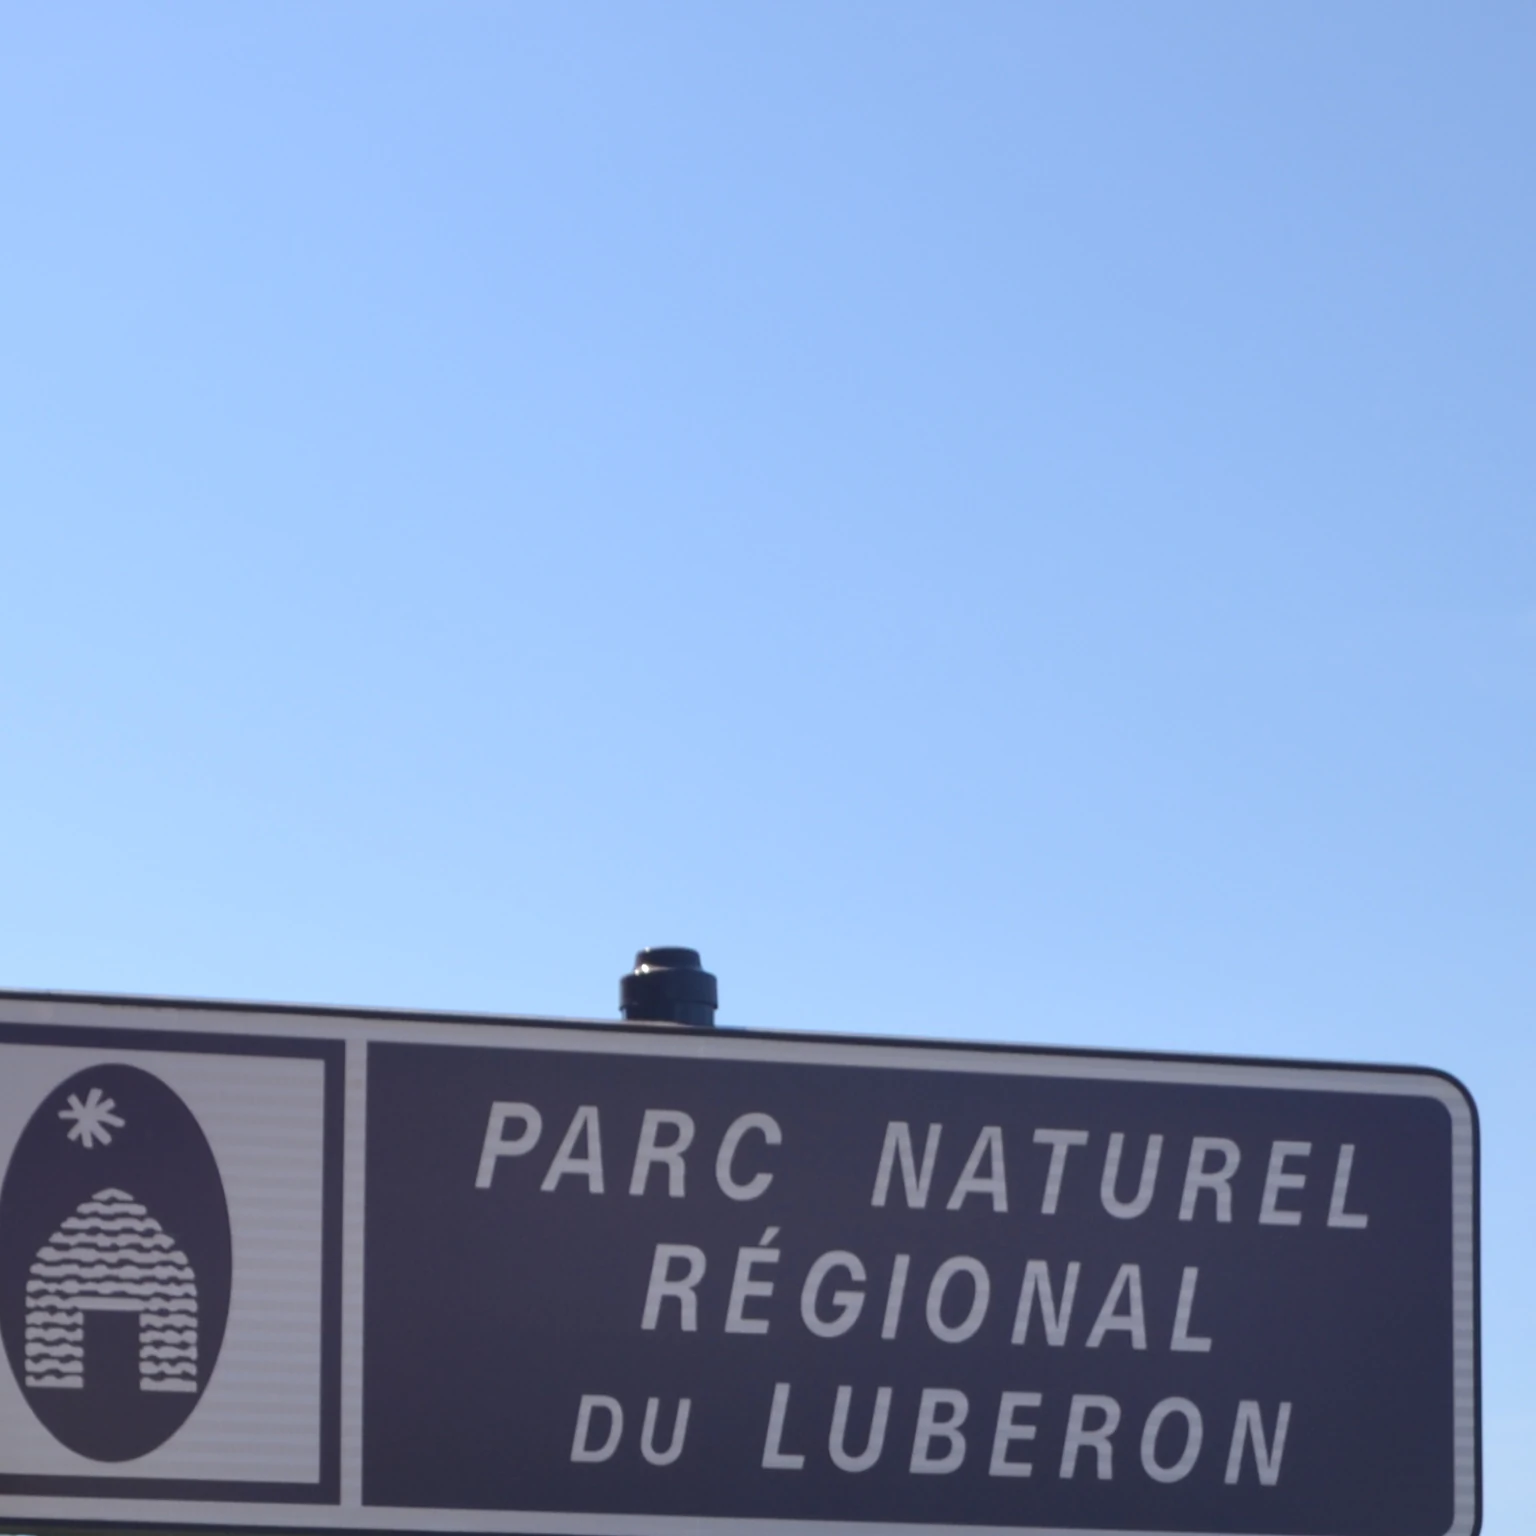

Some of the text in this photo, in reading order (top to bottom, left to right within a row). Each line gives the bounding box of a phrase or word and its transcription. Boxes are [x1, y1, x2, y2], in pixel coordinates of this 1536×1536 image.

[473, 1100, 1368, 1229] PARC NATUREL
[640, 1227, 1212, 1352] RÉGIONAL
[570, 1382, 1292, 1486] DU LUBERON
